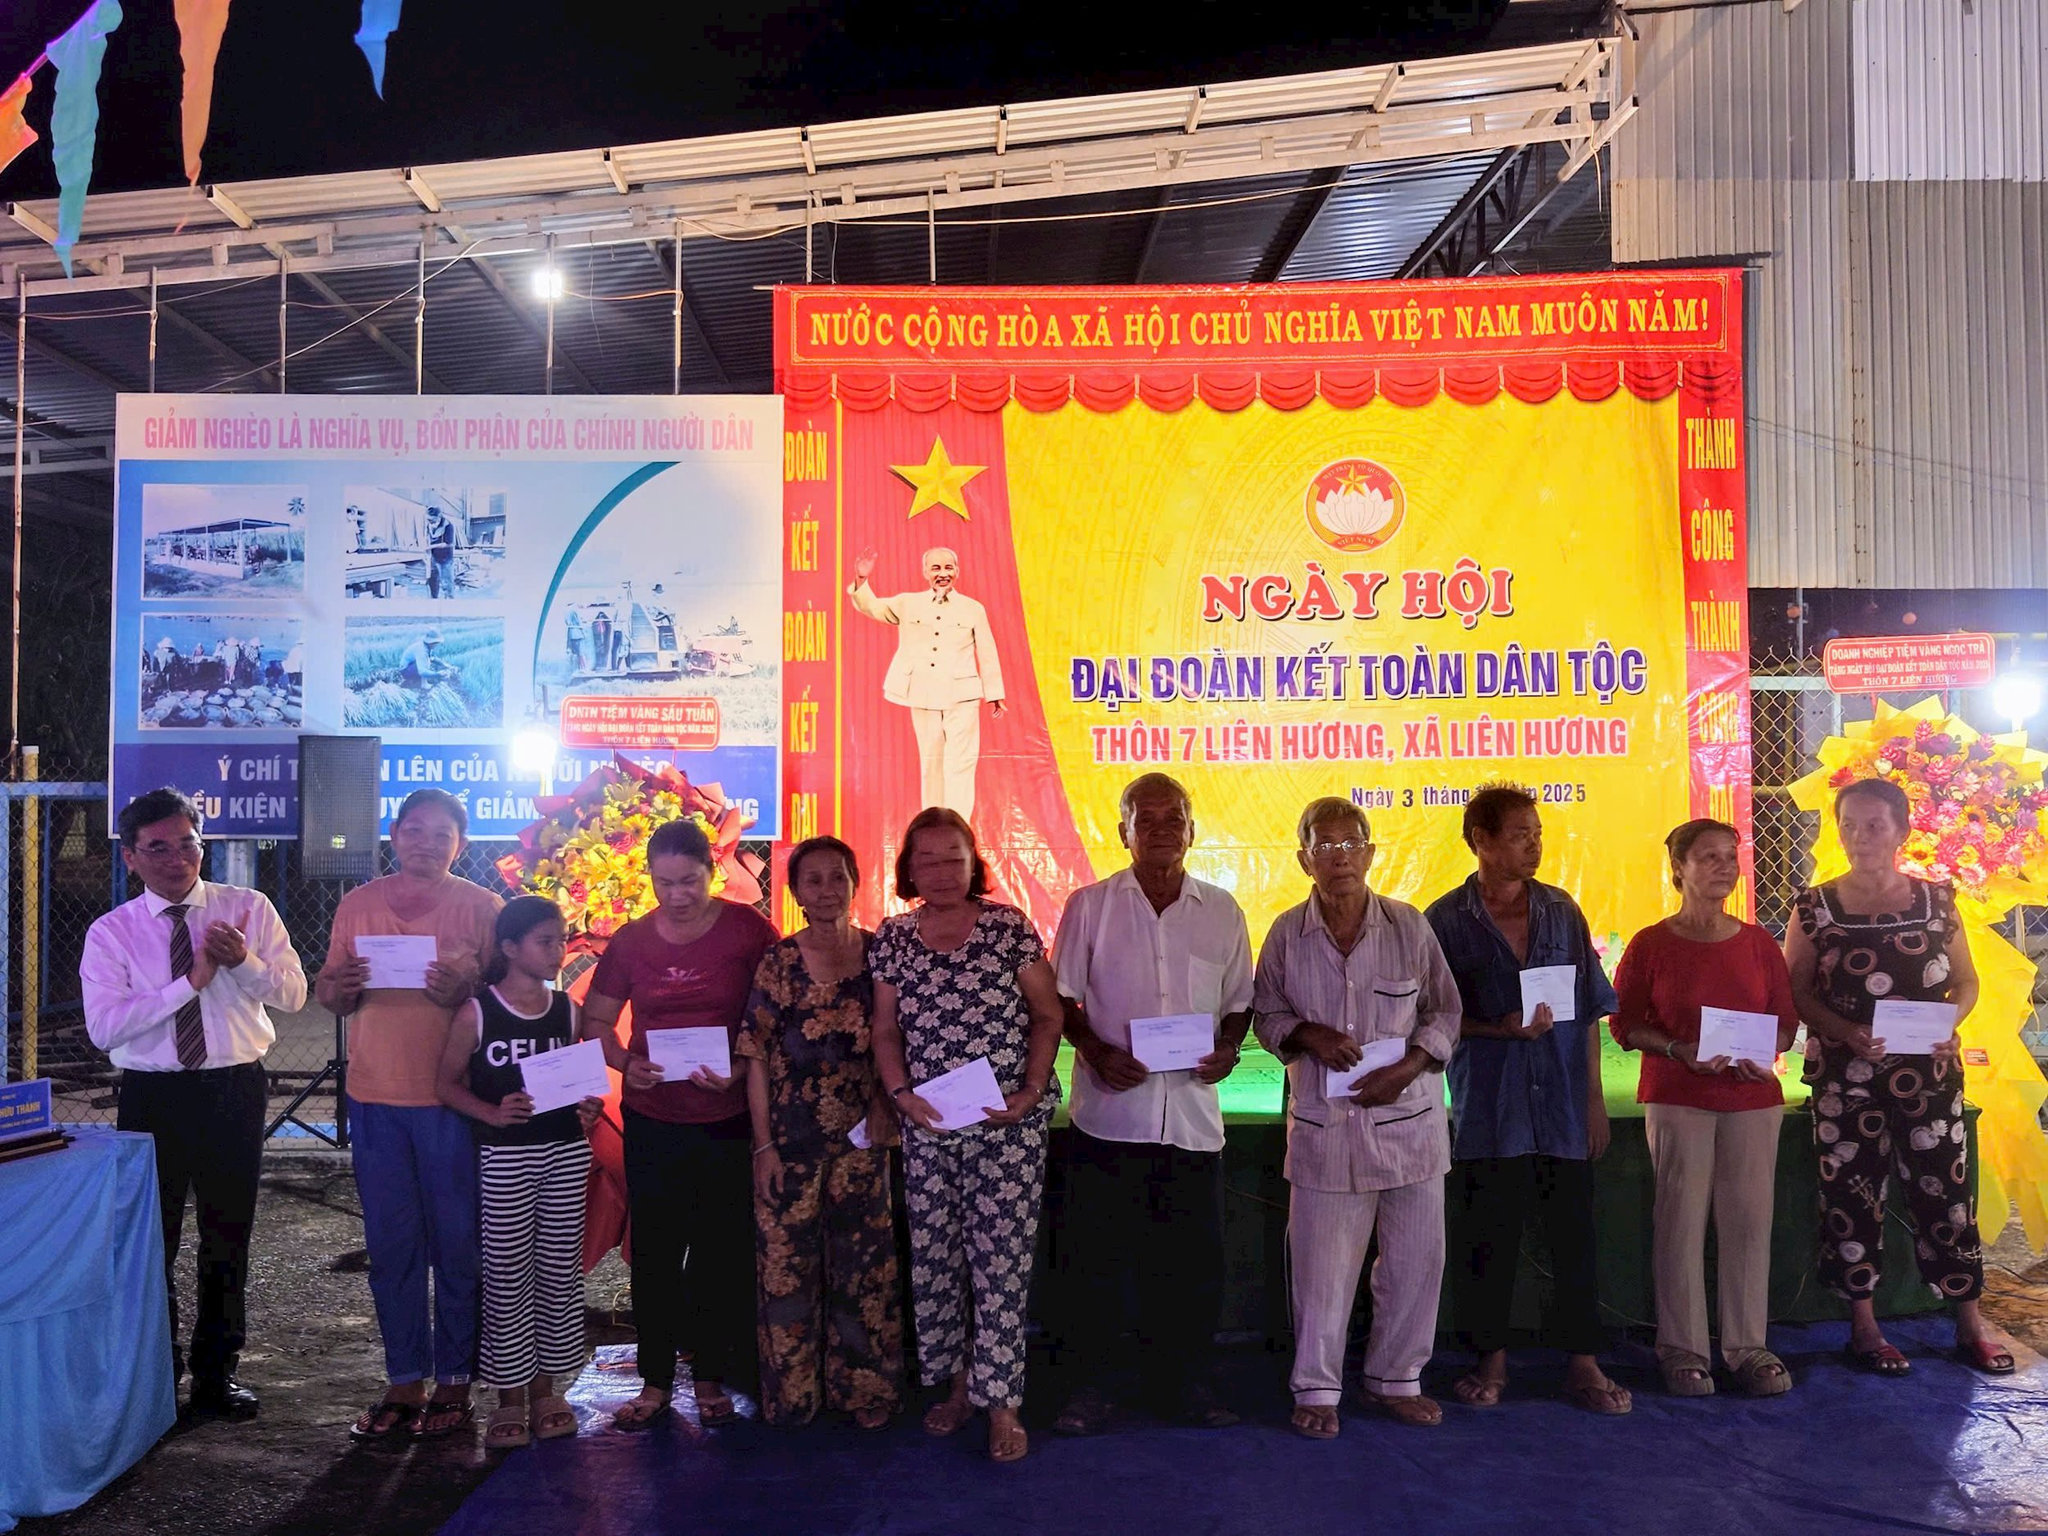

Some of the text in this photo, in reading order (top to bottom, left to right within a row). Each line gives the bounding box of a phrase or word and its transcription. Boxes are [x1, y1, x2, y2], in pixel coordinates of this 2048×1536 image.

[811, 288, 1709, 354] NƯỚC CỘNG HÒA XÃ HỘI CHỦ NGHĨA VIỆT NAM MUÔN NĂM!
[144, 407, 753, 457] GIẢM NGHÈO LÀ NGHĨA VỤ, BỔN PHẬN CỦA CHÍNH NGƯỜI DÂN
[785, 420, 827, 482] ĐOÀN
[1686, 407, 1736, 469] THÀNH
[791, 503, 819, 571] KẾT
[1691, 498, 1734, 562] CÔNG
[1202, 558, 1512, 629] NGÀY HỘI
[1690, 590, 1740, 652] THÀNH
[784, 600, 827, 662] ĐOÀN
[1831, 648, 1860, 660] DOANH
[1862, 644, 1894, 660] NGHIỆP
[1896, 643, 1917, 659] TIỆM
[1919, 642, 1941, 657] VÀNG
[1943, 643, 1965, 656] NGỌC
[1071, 640, 1647, 711] ĐẠI ĐOÀN KẾT TOÀN DÂN TỘC
[1862, 675, 1888, 685] THÔN
[1891, 677, 1898, 685] 7
[1901, 674, 1922, 684] LIÊN
[569, 706, 598, 718] DNTN
[601, 704, 627, 720] TIỆM
[630, 704, 659, 719] VÀNG
[790, 685, 819, 753] KẾT
[1092, 715, 1627, 763] THÔN 7 LIÊN HƯƠNG, XÃ LIÊN HƯƠNG
[217, 754, 232, 782] Ý
[240, 754, 280, 782] CHÍ
[398, 755, 443, 782] LÊN
[450, 752, 499, 782] CỦA
[1351, 787, 1394, 808] Ngày
[1402, 789, 1413, 807] 3
[1424, 786, 1469, 806] tháng
[1543, 784, 1586, 802] 2025
[229, 792, 286, 823] KIỆN
[476, 791, 539, 820] GIẢM
